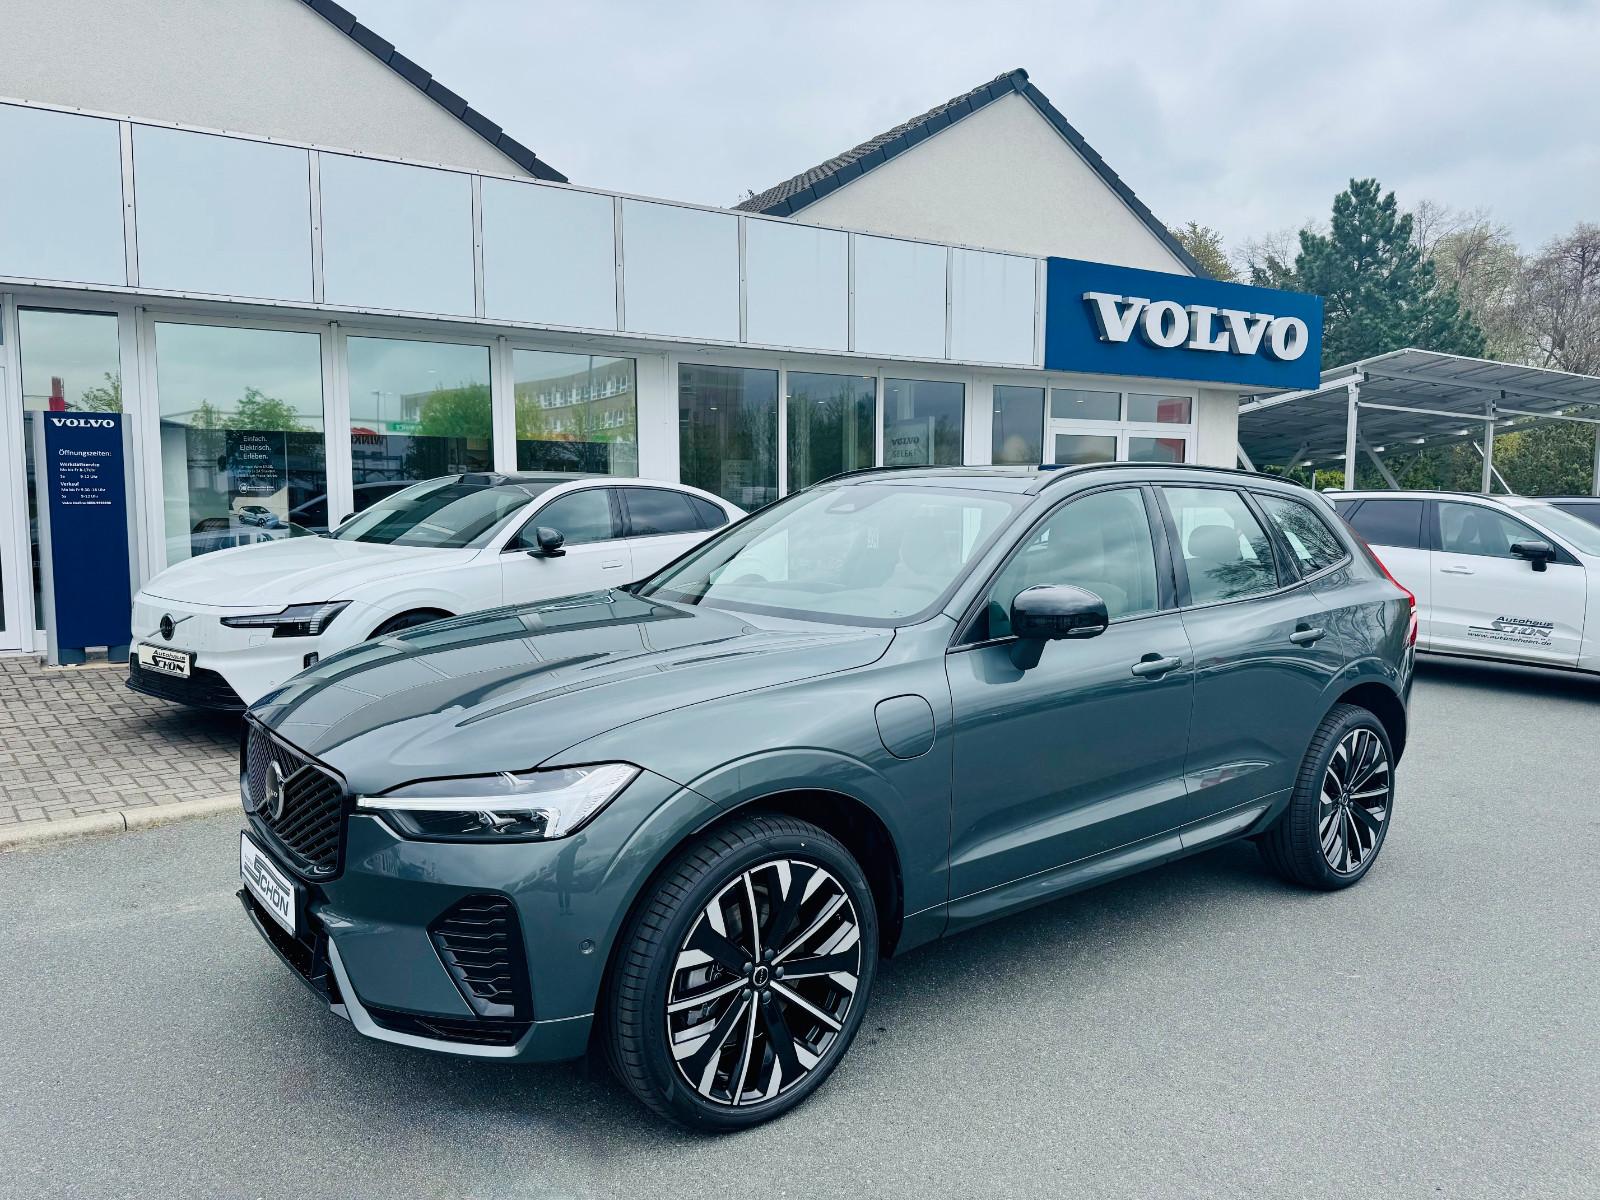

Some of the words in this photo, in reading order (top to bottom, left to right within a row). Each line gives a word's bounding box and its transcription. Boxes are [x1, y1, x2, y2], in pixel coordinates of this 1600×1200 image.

[1082, 291, 1309, 361] VOLVO
[50, 418, 115, 428] VOLVO
[891, 436, 920, 446] VOLVO
[58, 449, 112, 458] Öffnungszeiten:
[243, 452, 269, 460] Erleben.
[1496, 616, 1554, 627] Autohaus
[153, 650, 186, 661] Autohaus
[244, 853, 290, 917] SCHÖN
